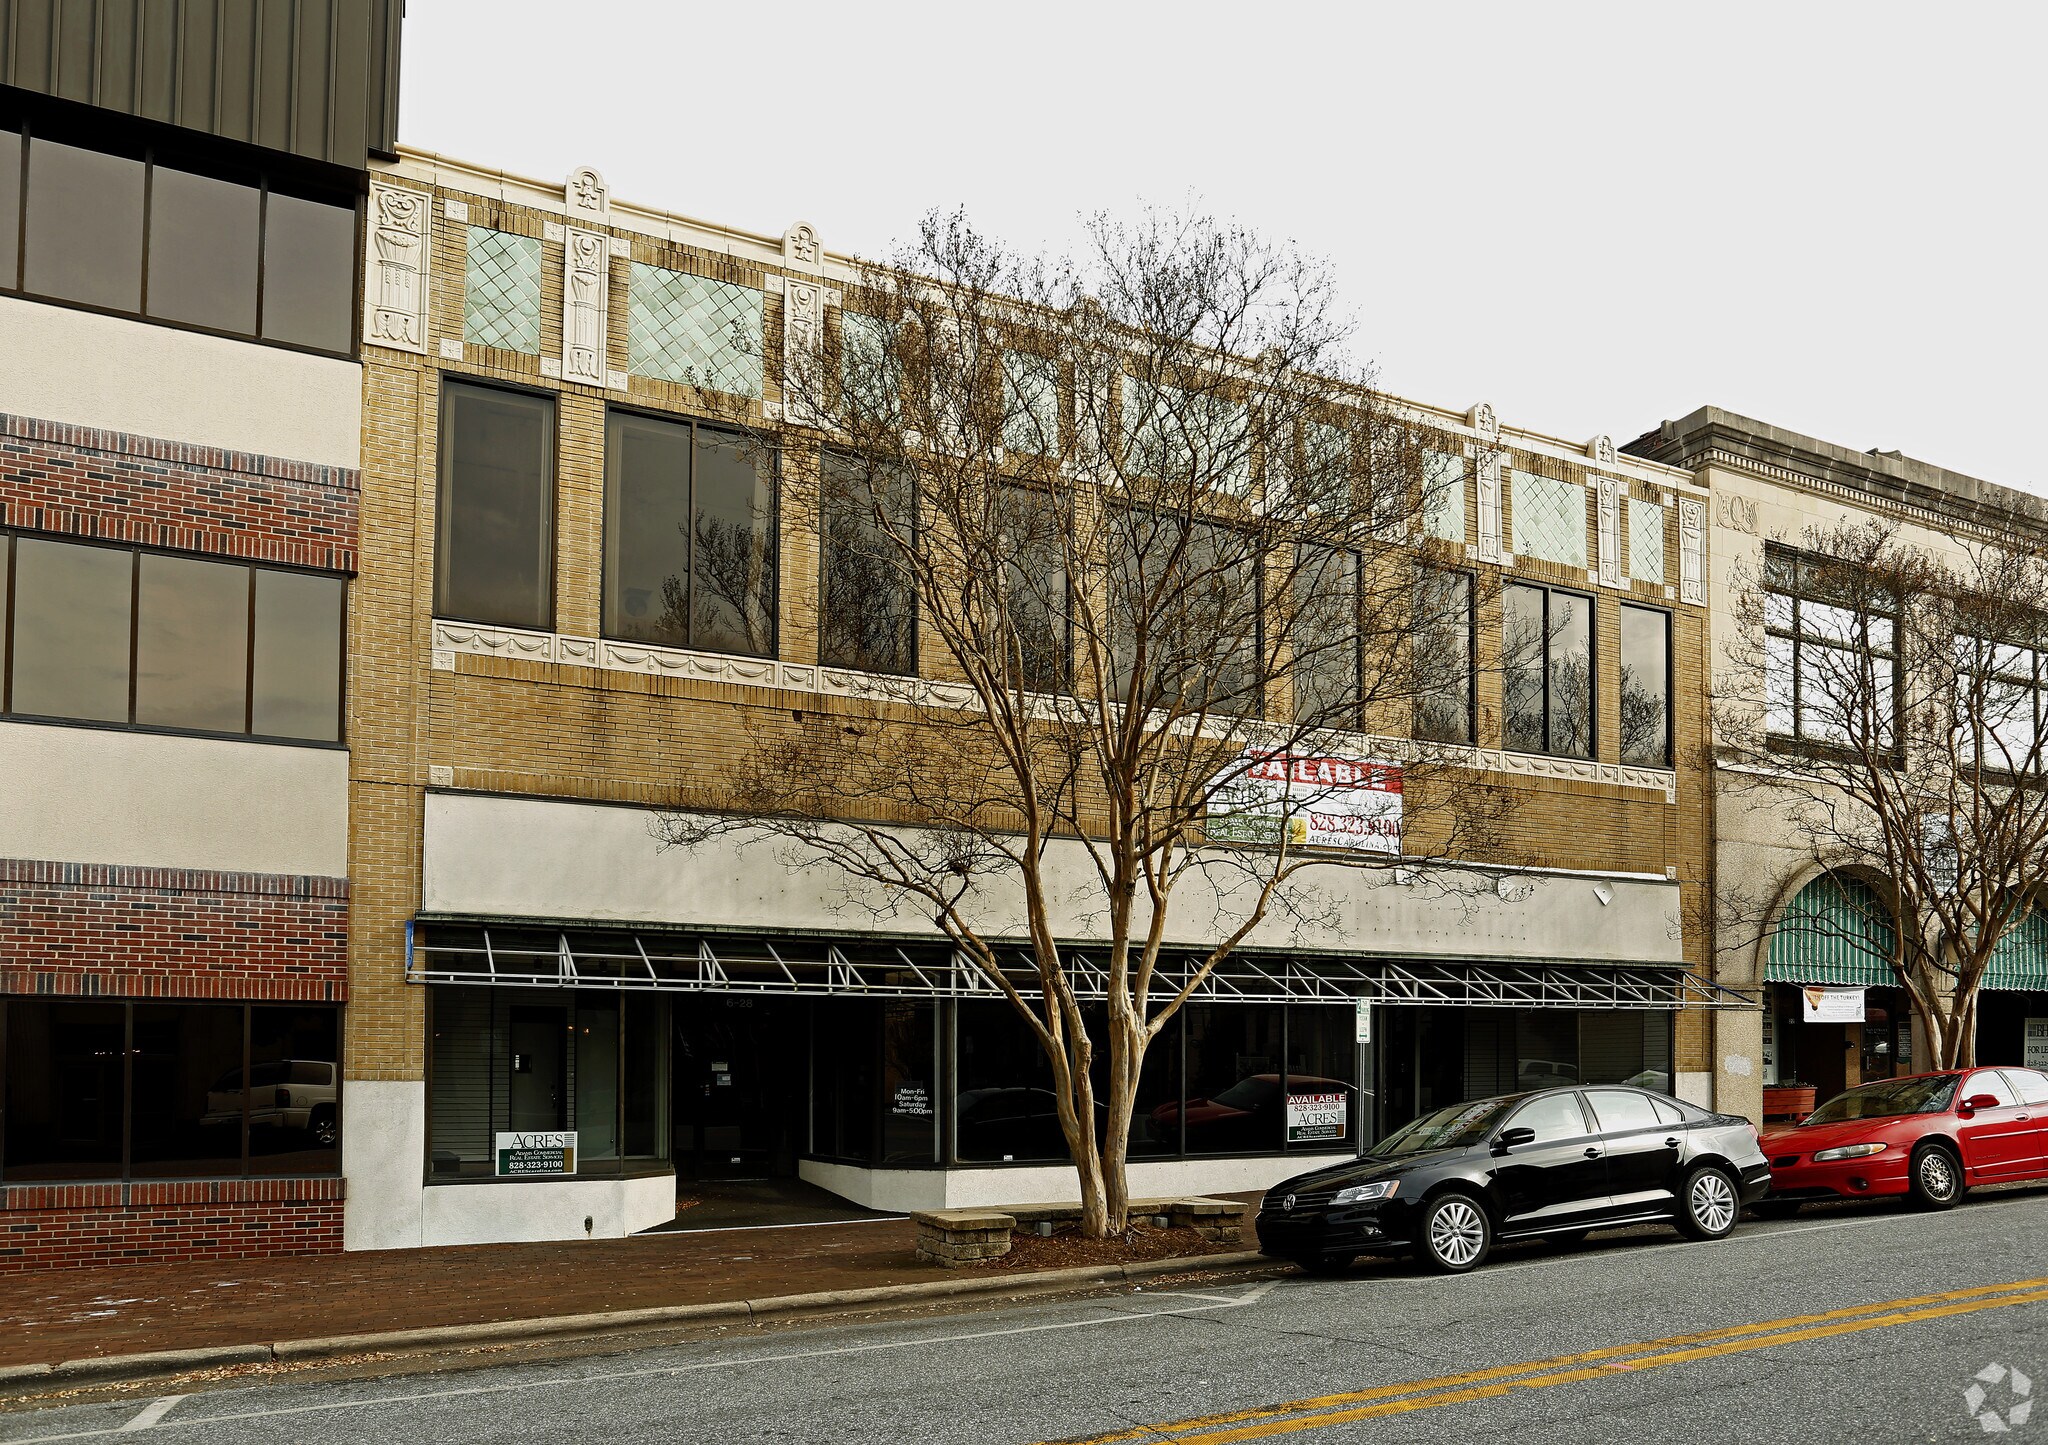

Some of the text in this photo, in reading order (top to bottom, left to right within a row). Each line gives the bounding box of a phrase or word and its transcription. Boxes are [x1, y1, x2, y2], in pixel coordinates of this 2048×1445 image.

[1288, 1095, 1345, 1103] AVAILABLE
[1298, 1113, 1337, 1125] ACRES
[510, 1133, 563, 1148] ACRES
